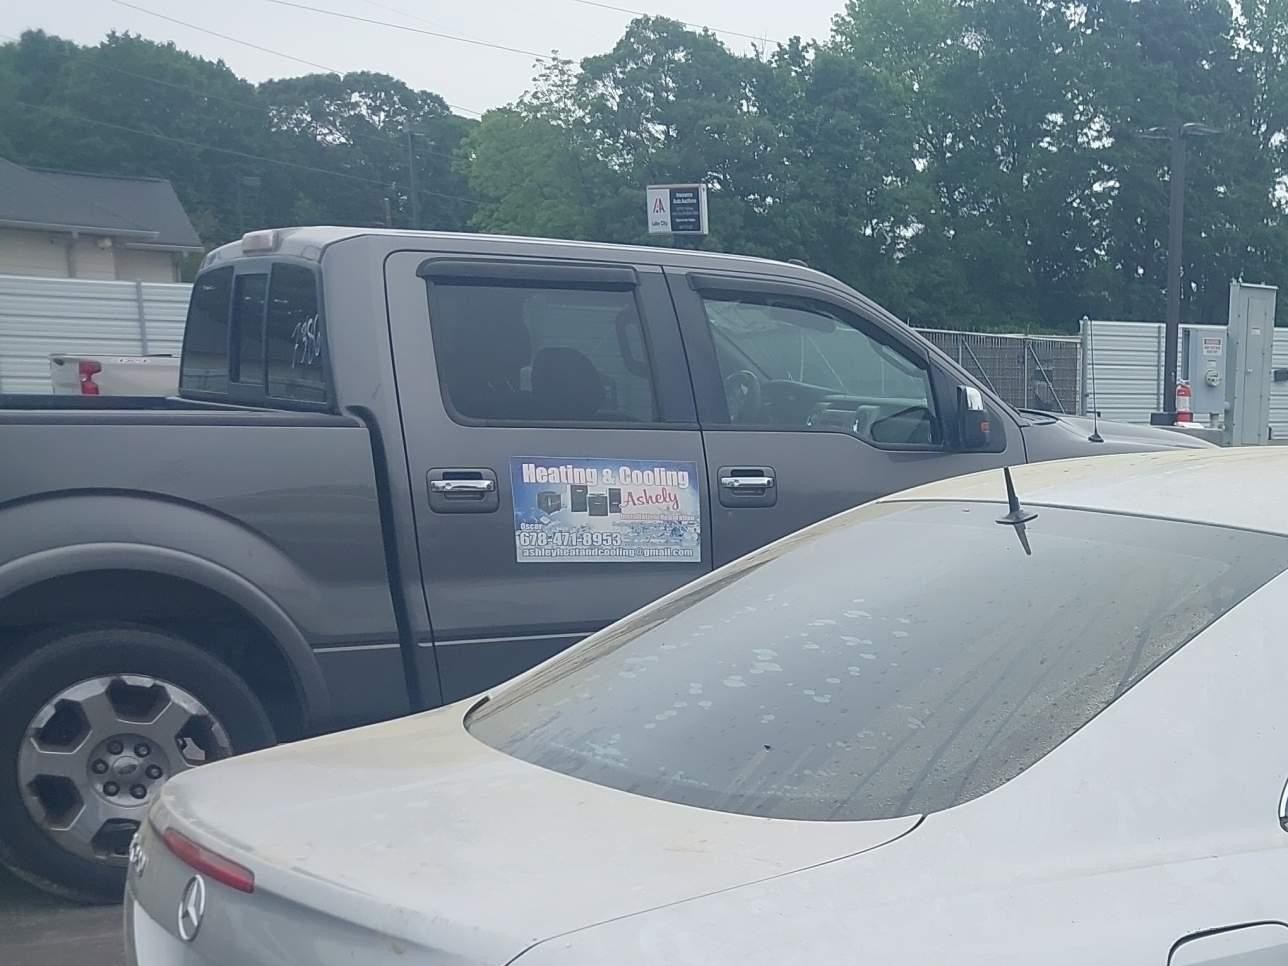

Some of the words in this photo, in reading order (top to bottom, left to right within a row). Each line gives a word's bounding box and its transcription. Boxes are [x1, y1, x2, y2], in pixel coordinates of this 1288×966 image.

[522, 463, 597, 486] Heating
[602, 468, 616, 484] &
[619, 466, 689, 489] Cooling
[622, 488, 680, 511] Ashely
[519, 532, 622, 547] 678-471-8953
